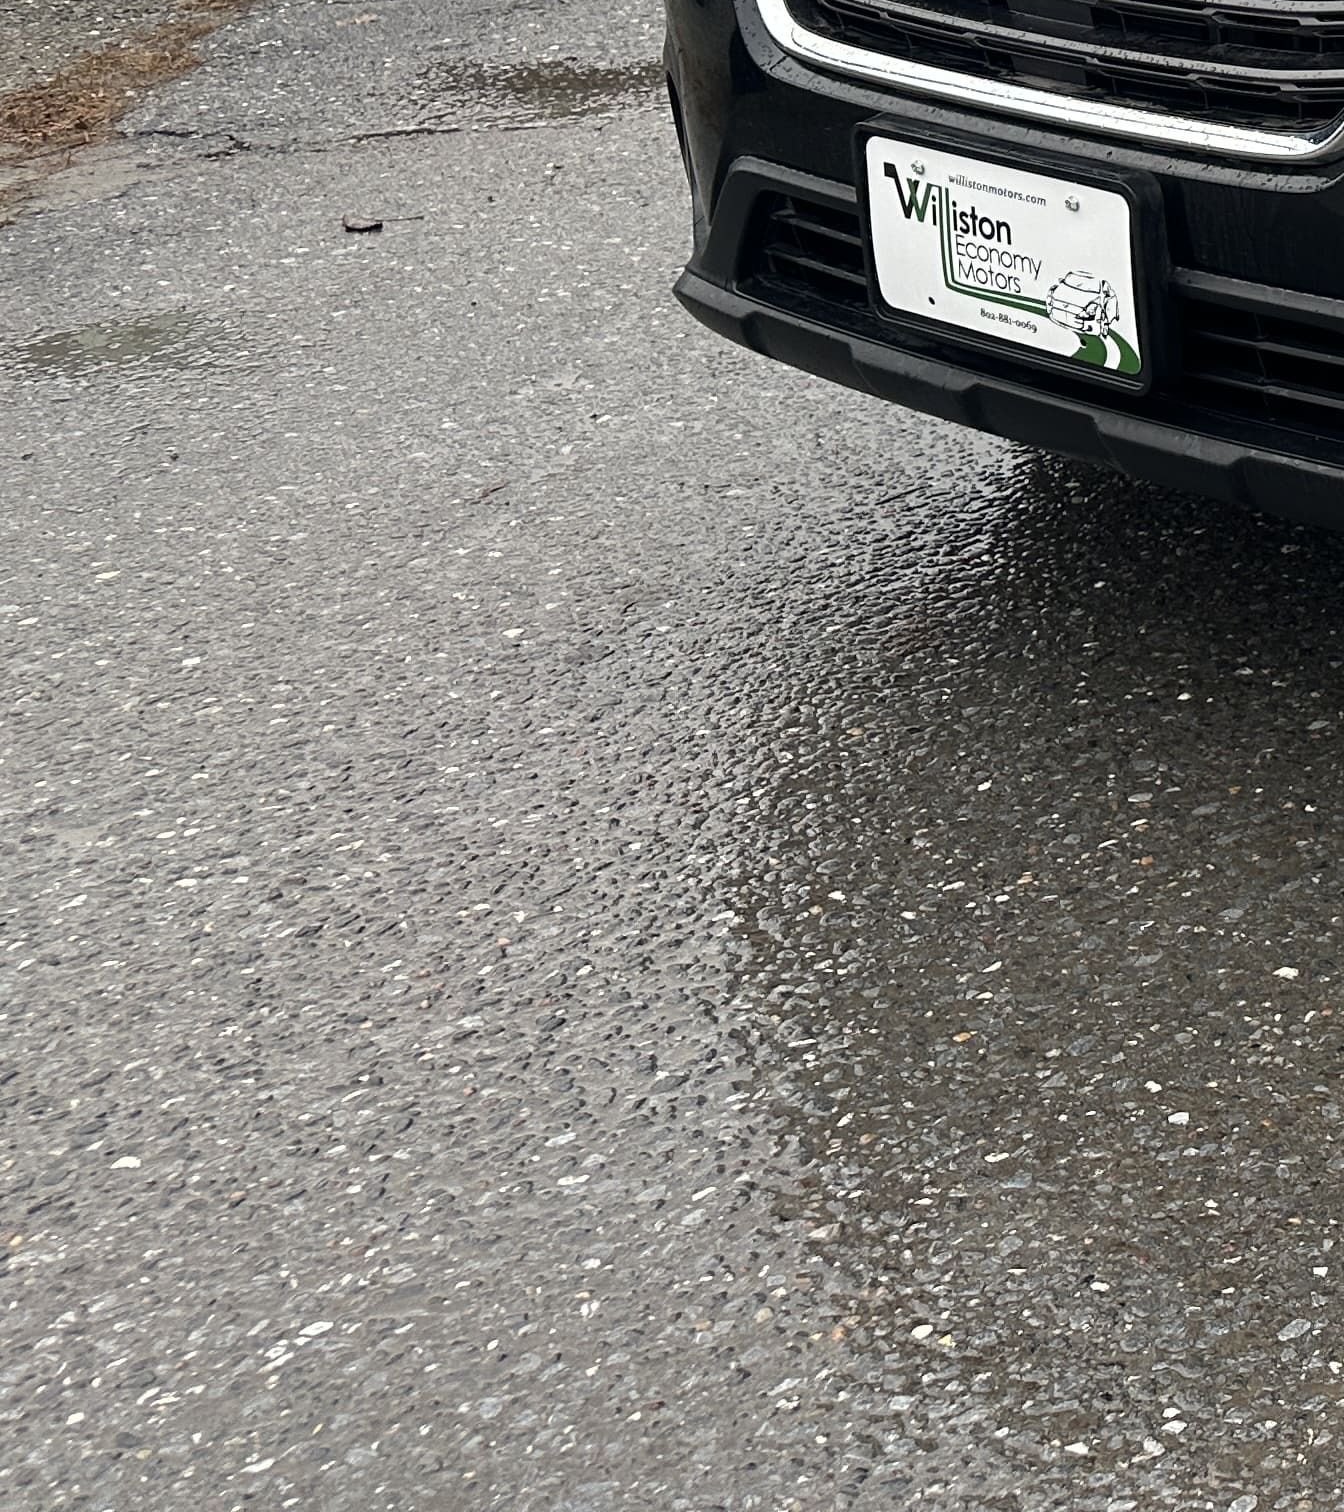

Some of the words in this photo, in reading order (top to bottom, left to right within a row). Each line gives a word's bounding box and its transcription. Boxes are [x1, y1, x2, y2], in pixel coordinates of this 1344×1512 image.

[883, 161, 1012, 245] Williston
[948, 174, 1047, 207] willistonmotors.com
[955, 234, 1043, 280] Economy
[958, 259, 1022, 294] Motors
[979, 308, 1038, 333] 802-881-0069
